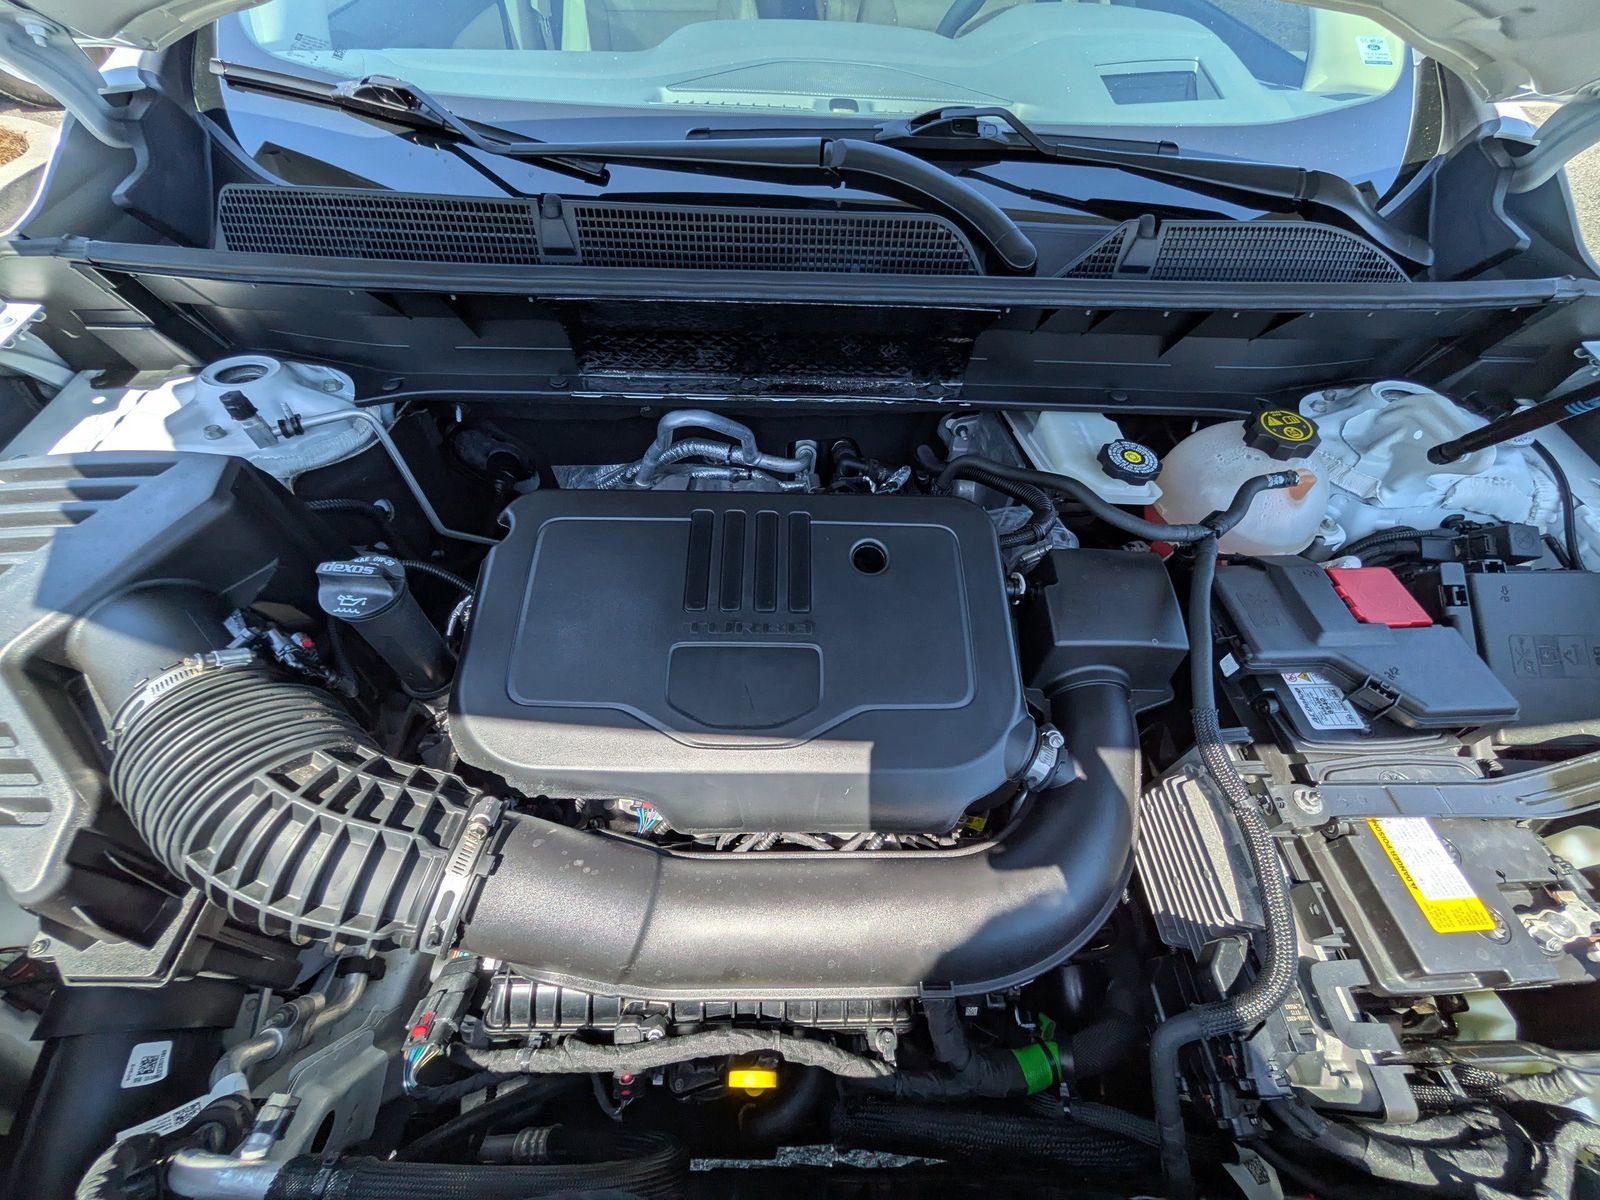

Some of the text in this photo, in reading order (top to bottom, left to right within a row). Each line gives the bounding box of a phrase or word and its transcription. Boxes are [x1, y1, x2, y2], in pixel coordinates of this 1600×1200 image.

[373, 557, 395, 566] 0W-20
[323, 562, 375, 575] dexos
[682, 621, 814, 636] TURBO
